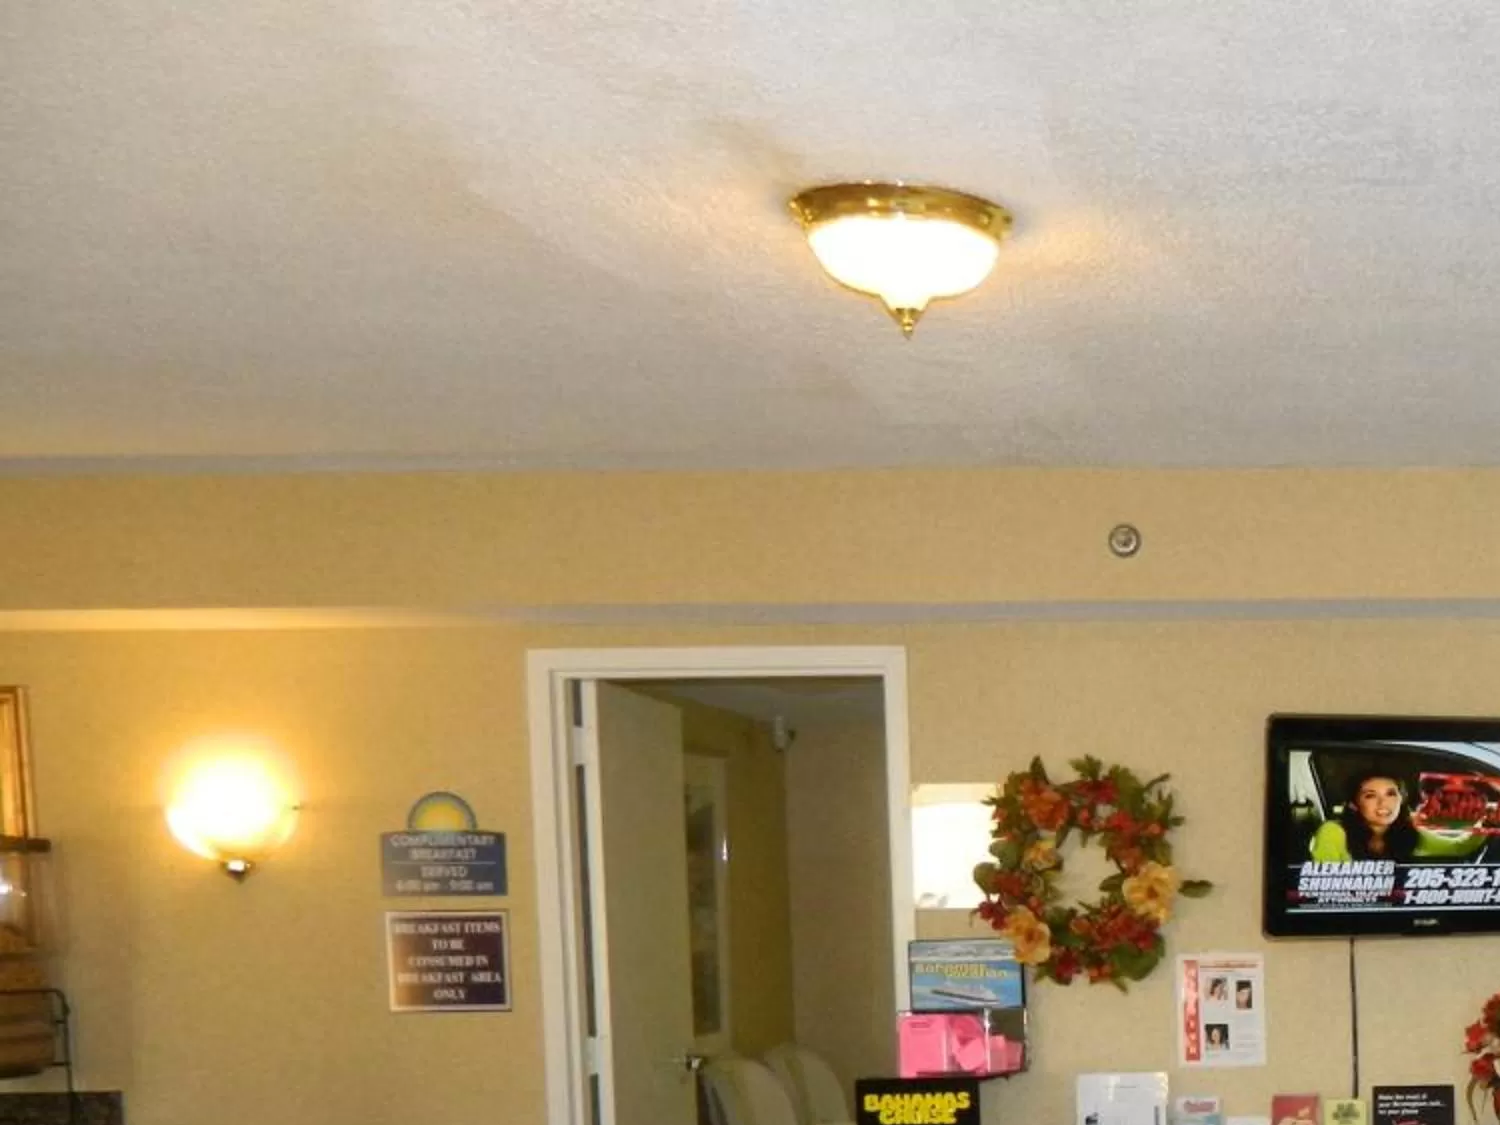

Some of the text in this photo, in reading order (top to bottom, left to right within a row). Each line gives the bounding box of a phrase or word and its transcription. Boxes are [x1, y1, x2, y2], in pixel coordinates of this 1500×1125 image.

[390, 834, 496, 847] COMPLIMENTARY
[408, 848, 477, 860] BREAKFAST
[420, 866, 469, 877] SERVED
[1301, 860, 1395, 876] ALEXANDER
[395, 921, 501, 934] BREAKFAST ITEMS
[432, 939, 464, 950] TO BE
[407, 955, 489, 967] CONSUMED IN
[397, 971, 502, 984] BREAKFAST AREA
[433, 988, 467, 1000] ONLY
[864, 1092, 970, 1112] BAHAMAS
[879, 1107, 957, 1125] CRUISE
